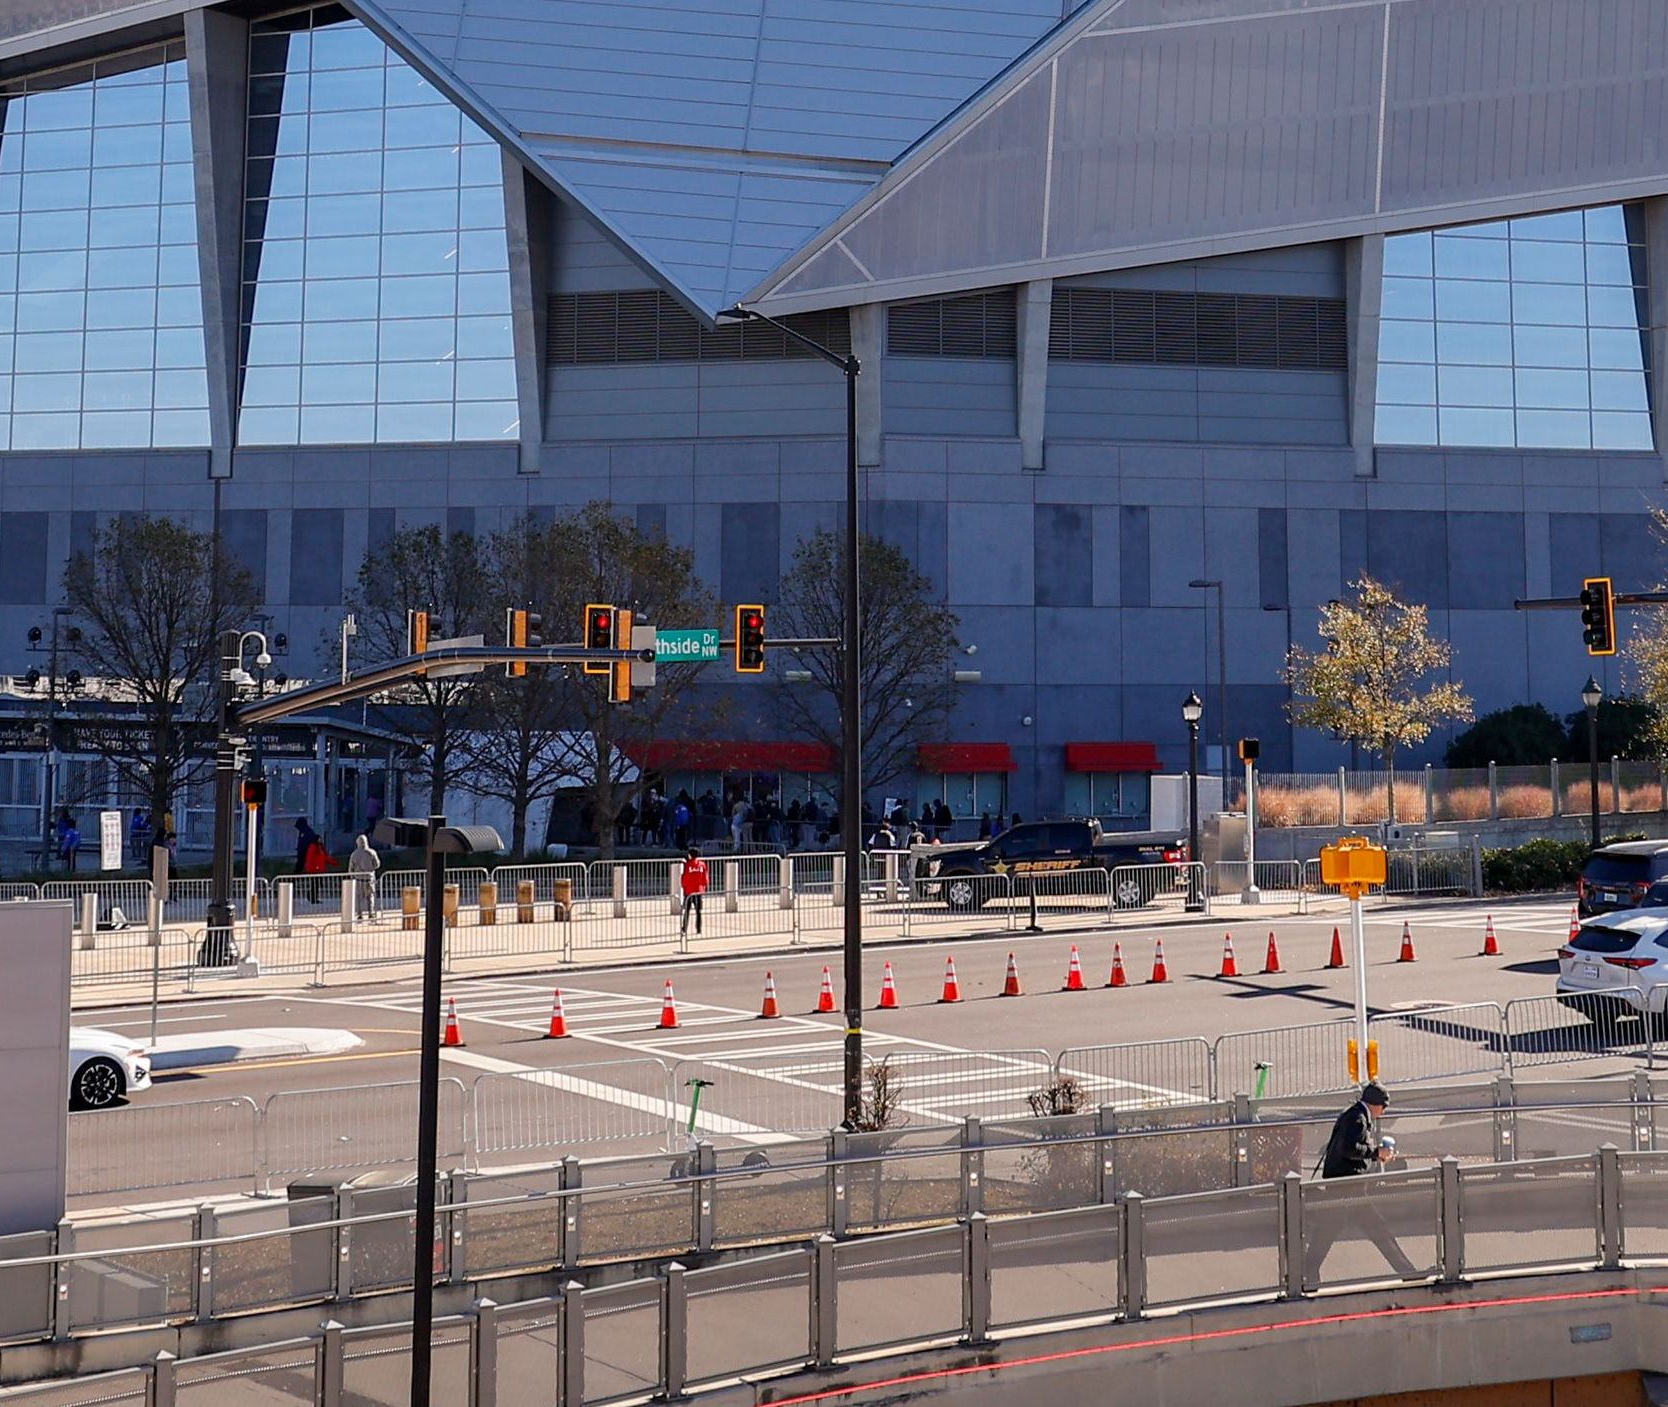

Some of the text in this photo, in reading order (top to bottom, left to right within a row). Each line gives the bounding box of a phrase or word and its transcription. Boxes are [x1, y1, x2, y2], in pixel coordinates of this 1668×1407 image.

[654, 633, 716, 655] thside Dr
[701, 645, 718, 657] NW
[1014, 859, 1082, 872] SHERIFF
